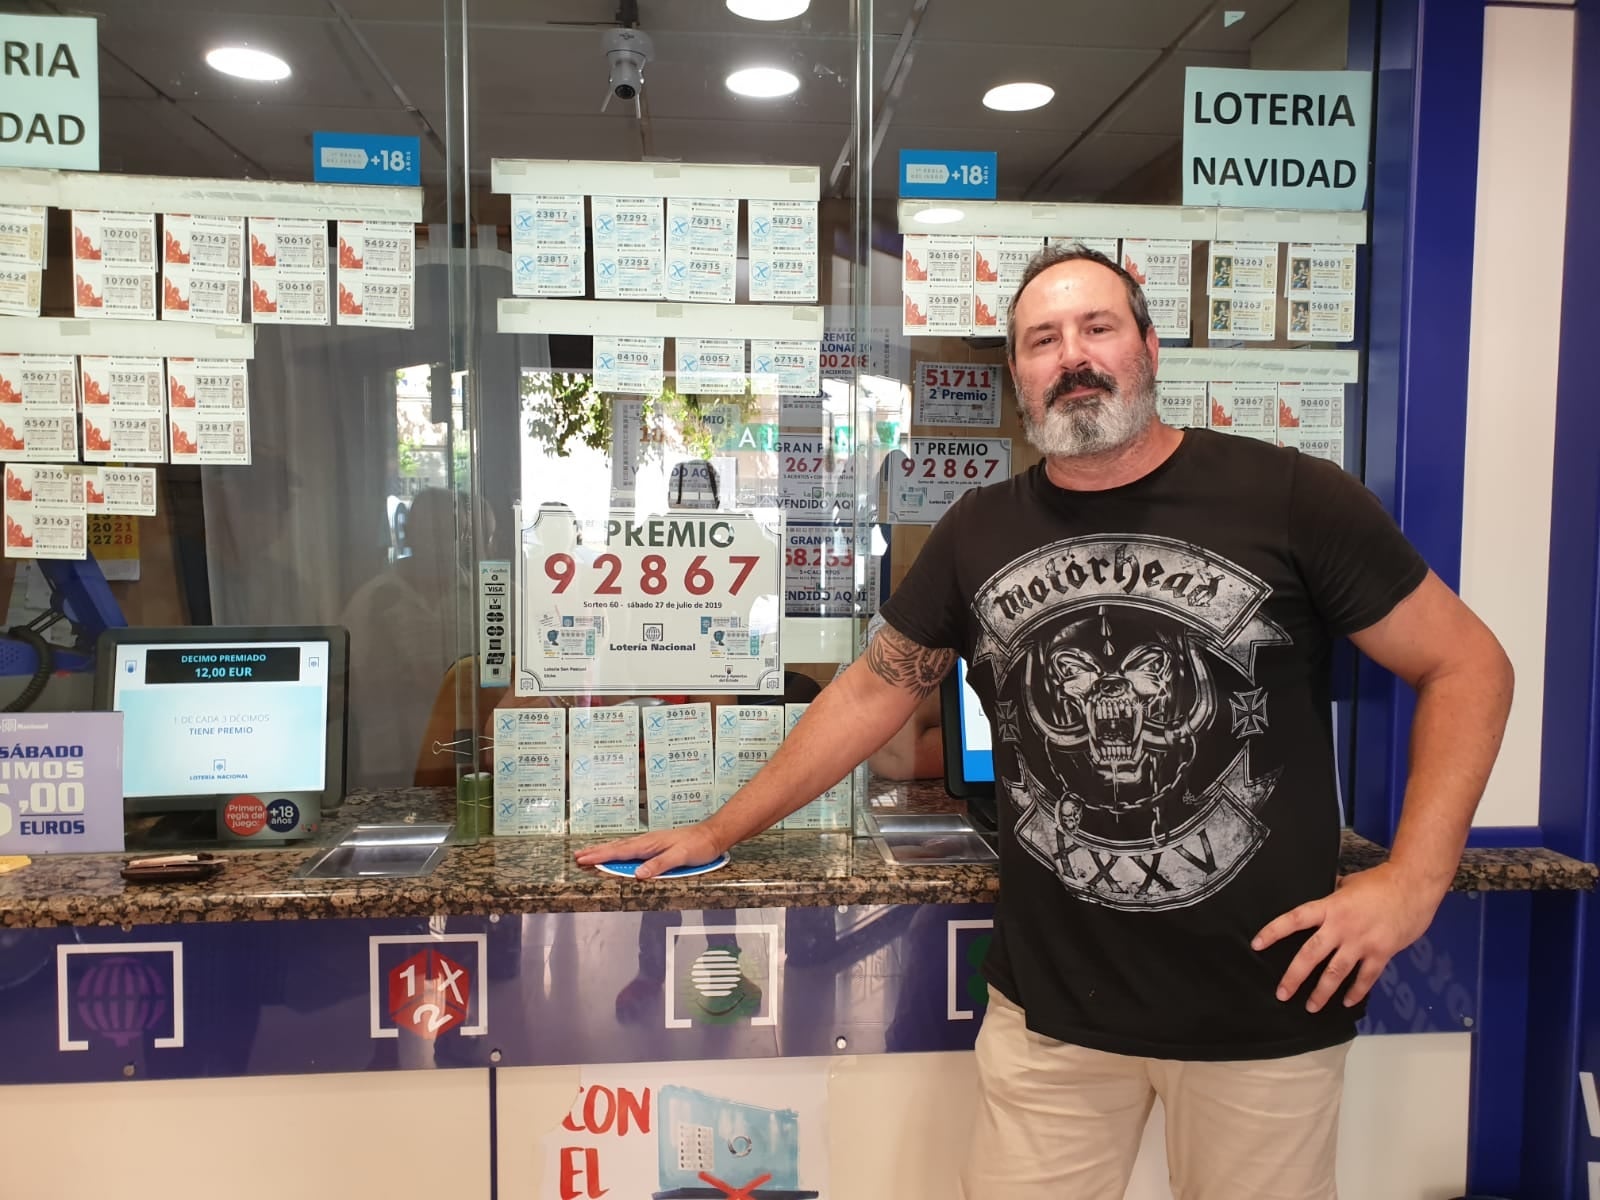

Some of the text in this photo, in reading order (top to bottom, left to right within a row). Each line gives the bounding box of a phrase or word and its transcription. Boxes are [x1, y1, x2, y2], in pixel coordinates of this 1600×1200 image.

[1194, 91, 1356, 128] LOTERIA
[371, 149, 405, 172] +18
[951, 164, 984, 186] +18
[1193, 157, 1357, 189] NAVIDAD
[925, 368, 992, 389] 51711
[942, 389, 988, 402] Premio
[927, 442, 989, 457] PREMIO
[900, 457, 1000, 479] 92867
[93, 522, 133, 533] 20 21
[606, 519, 737, 549] PREMIO
[94, 534, 112, 545] 27
[543, 552, 761, 598] 92867
[583, 600, 608, 609] Sorteo
[609, 601, 619, 609] 60
[627, 600, 654, 609] sábado
[655, 601, 664, 609] 27
[665, 601, 675, 609] de
[675, 601, 692, 611] julio
[693, 601, 704, 609] de
[704, 601, 723, 610] 2019
[609, 643, 697, 652] Lotería Nacional
[181, 653, 267, 664] DECIMO PREMIADO
[195, 666, 253, 679] 12,00 EUR
[189, 726, 254, 736] TIENE PREMIO
[0, 742, 84, 759] SÁBADO
[228, 804, 263, 812] Primera
[269, 805, 295, 819] +18
[227, 812, 265, 821] regla del
[271, 817, 293, 825] años
[19, 820, 85, 836] EUROS
[1051, 827, 1219, 896] XXXV
[559, 1146, 610, 1200] EL
